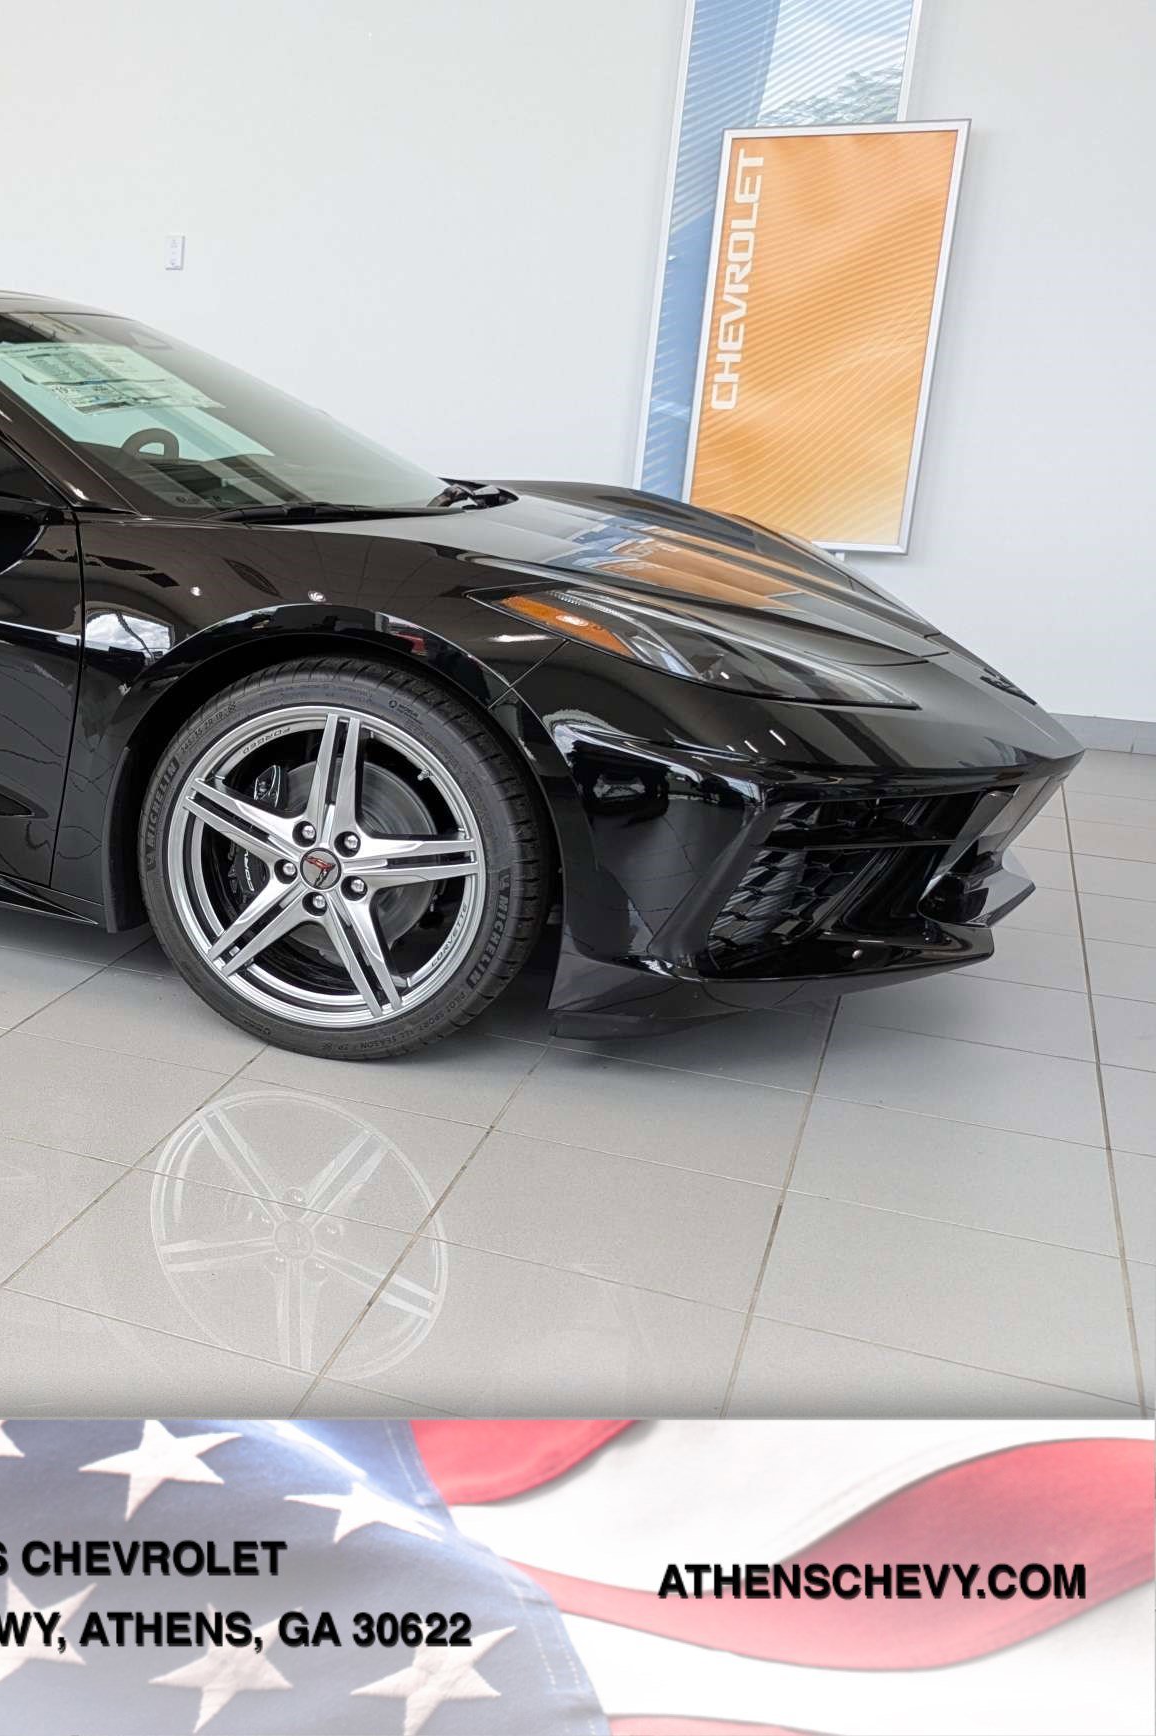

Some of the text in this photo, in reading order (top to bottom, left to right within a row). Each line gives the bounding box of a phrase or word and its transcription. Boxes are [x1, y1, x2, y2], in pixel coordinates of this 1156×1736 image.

[711, 148, 765, 410] CHEVROLET
[147, 757, 180, 849] MICHELIN
[431, 902, 469, 967] CORVETTE
[468, 893, 510, 989] MICHELIN
